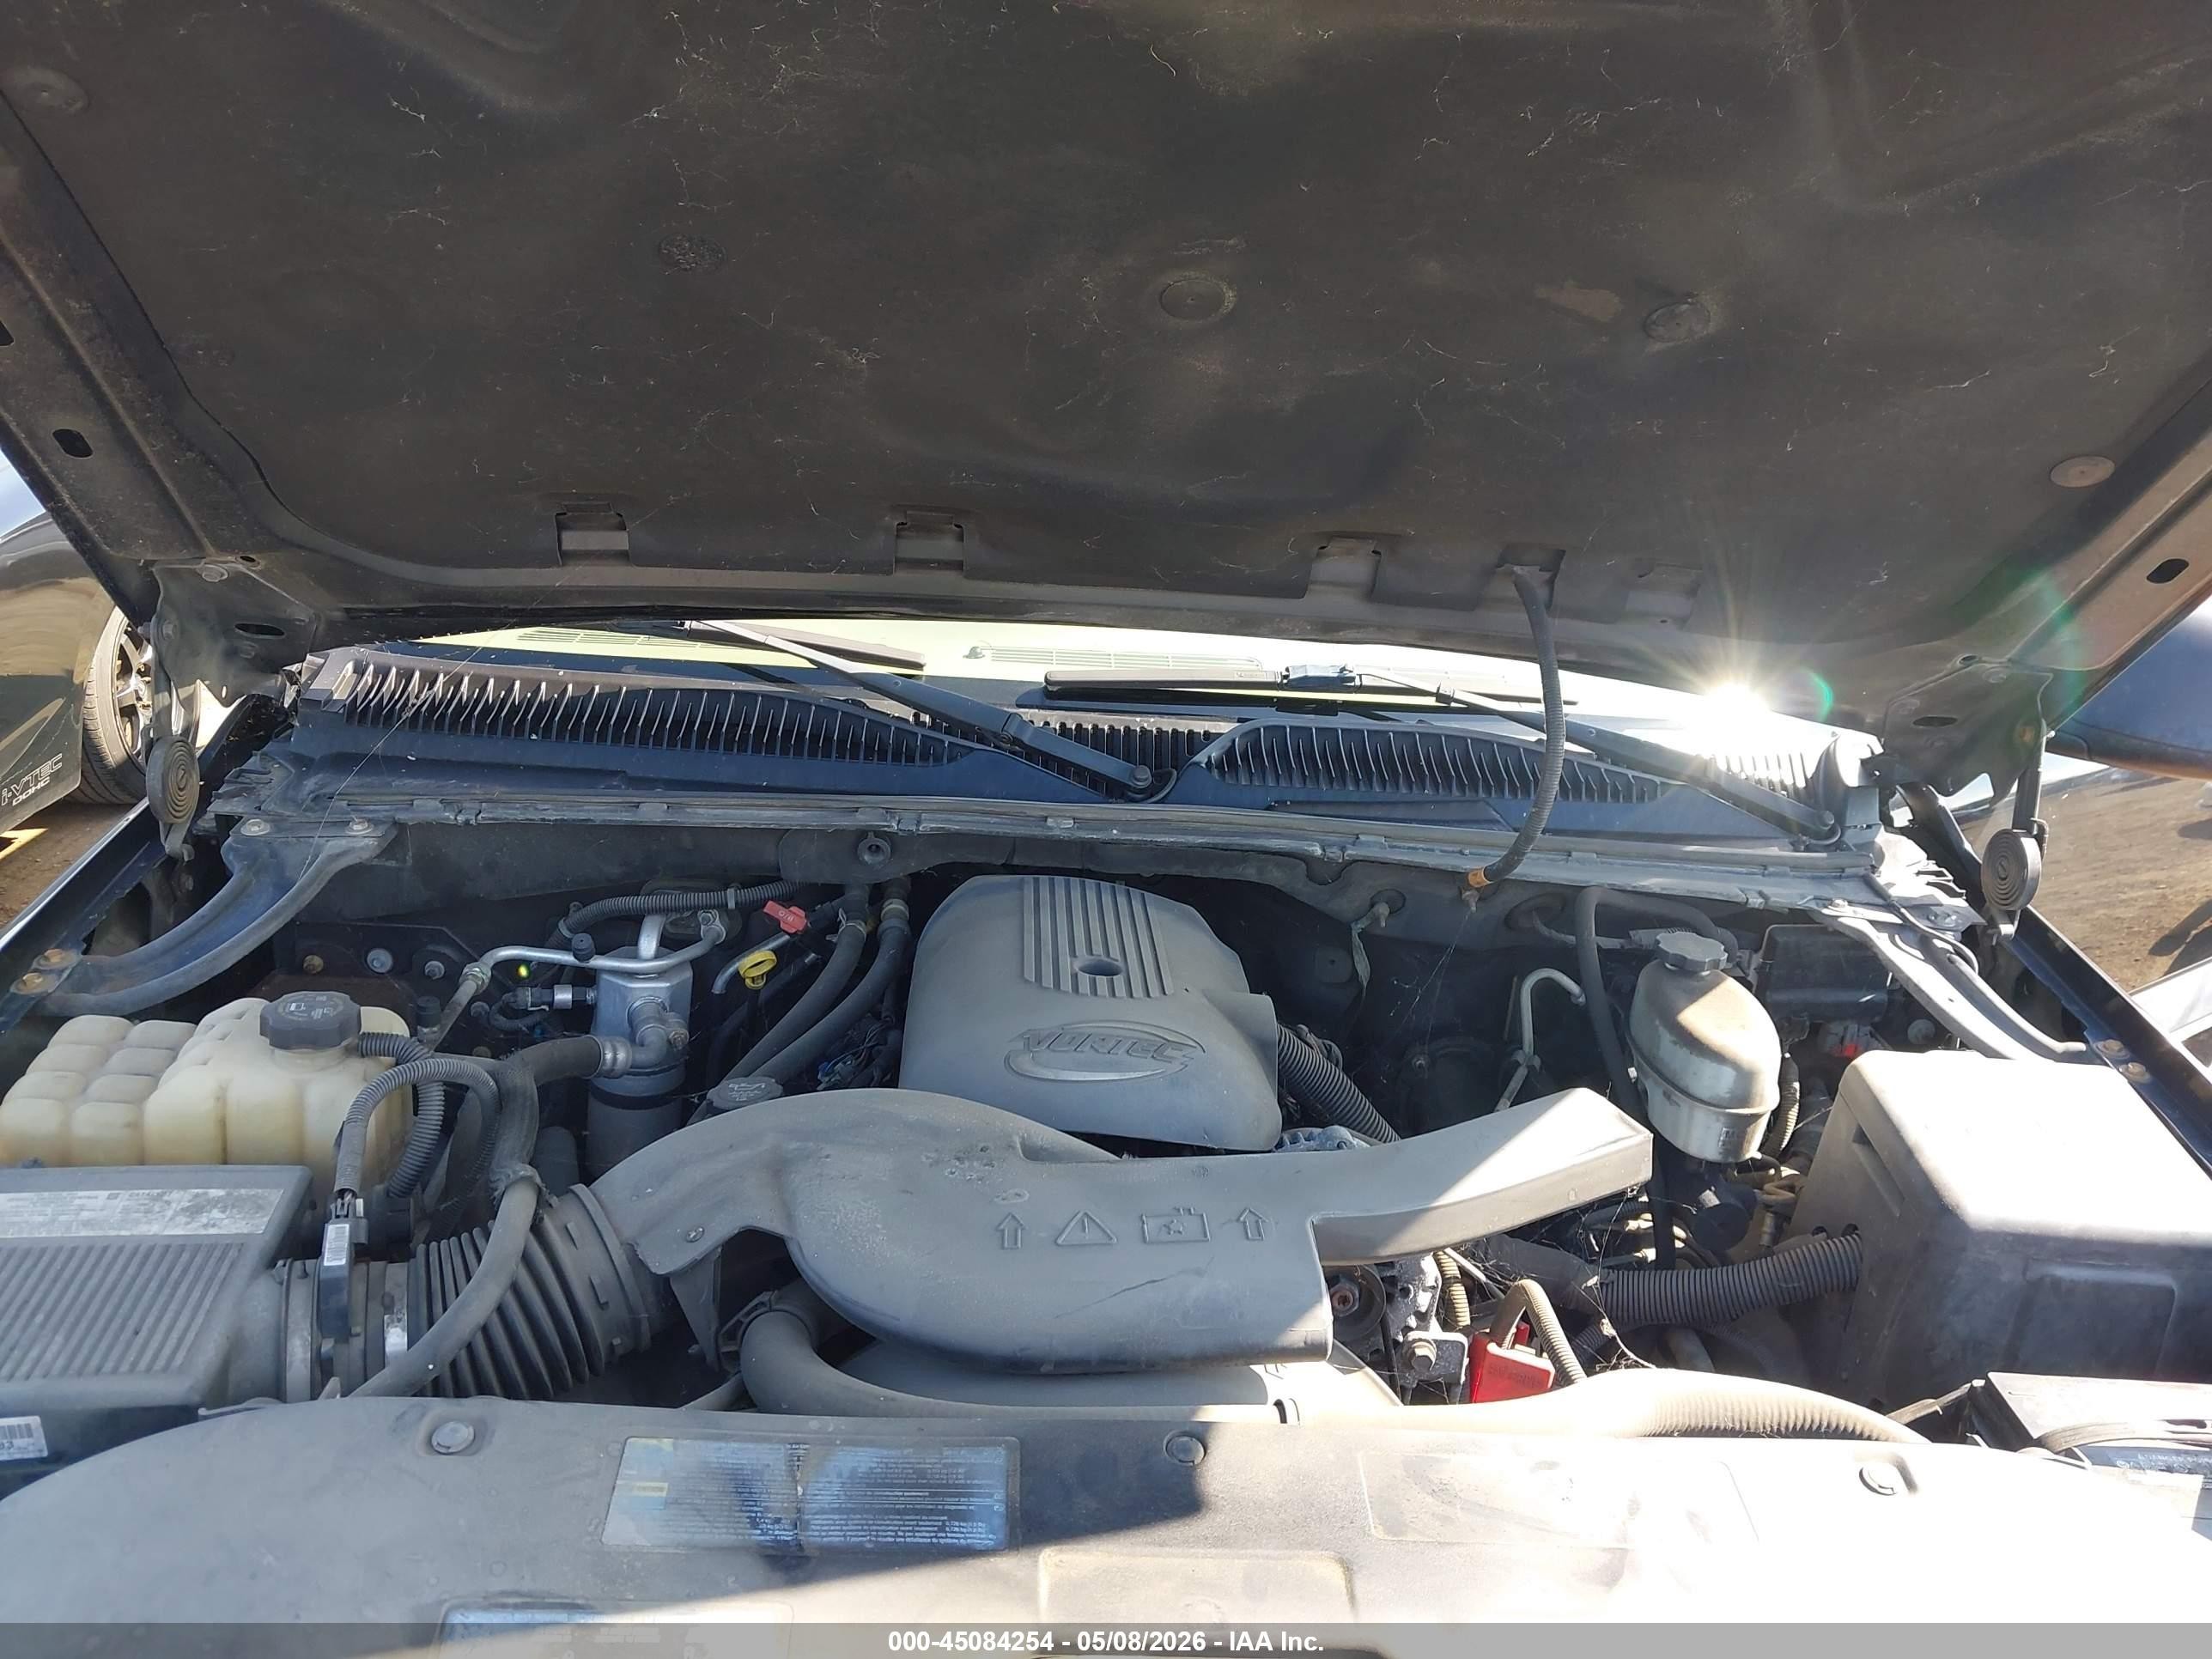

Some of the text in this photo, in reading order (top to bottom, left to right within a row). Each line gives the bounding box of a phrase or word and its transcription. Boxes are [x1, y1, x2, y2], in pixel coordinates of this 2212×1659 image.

[1, 753, 63, 806] i-VTEC
[12, 776, 51, 806] DOHC
[1023, 1028, 1198, 1065] VORTEC
